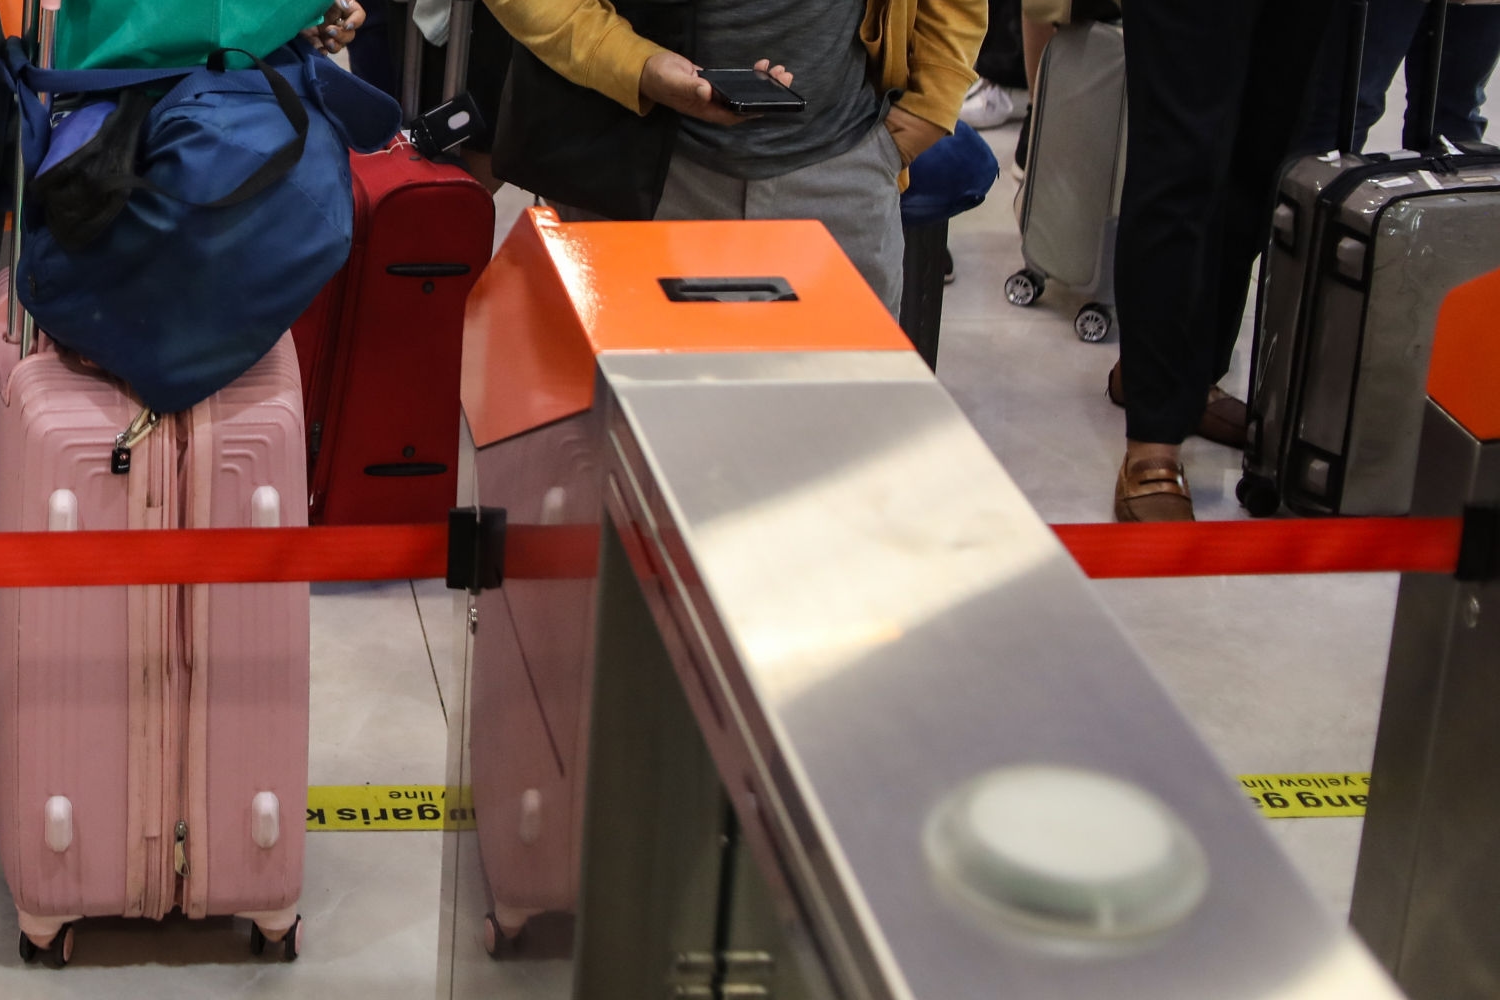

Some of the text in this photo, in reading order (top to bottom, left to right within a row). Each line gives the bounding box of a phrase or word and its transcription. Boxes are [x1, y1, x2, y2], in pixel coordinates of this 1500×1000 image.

[1279, 775, 1357, 789] yellow
[389, 790, 433, 802] line
[336, 803, 441, 825] garis
